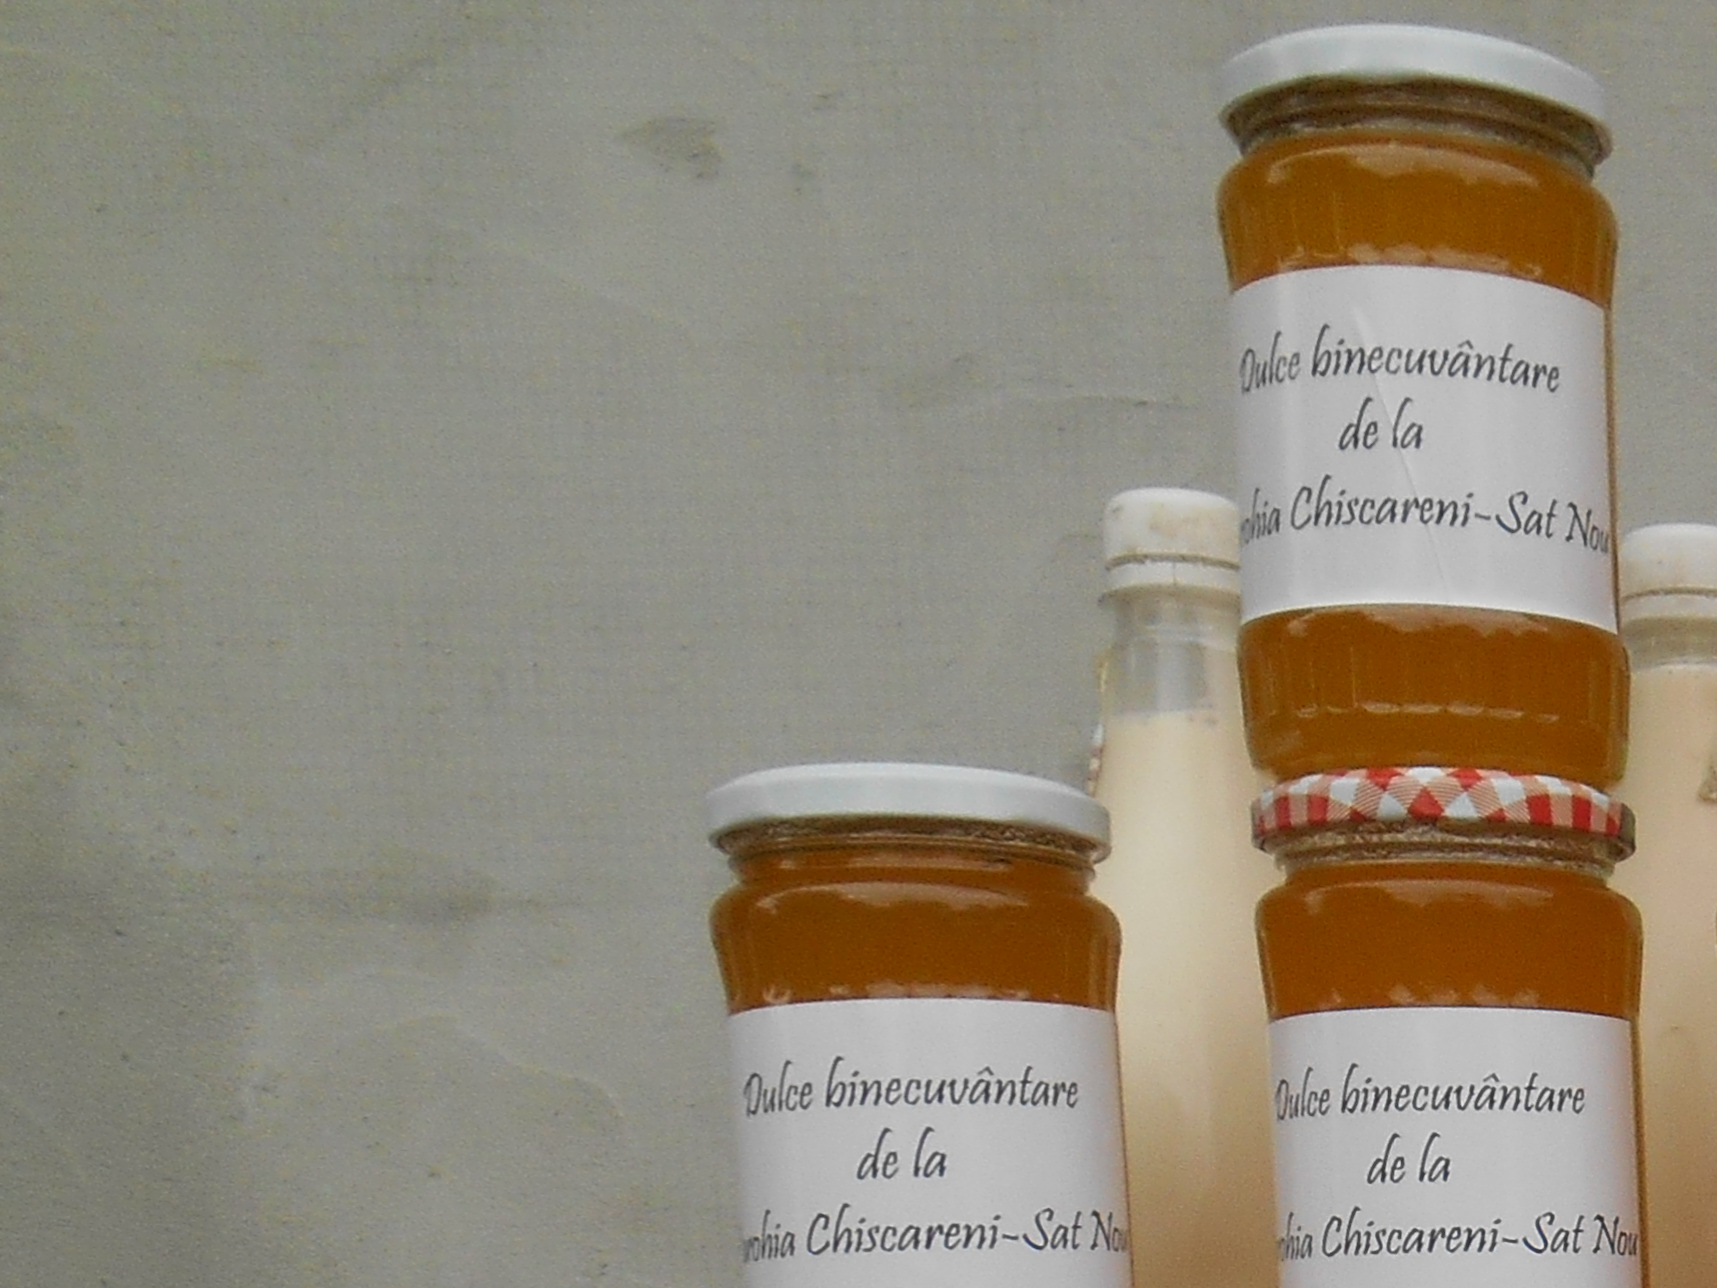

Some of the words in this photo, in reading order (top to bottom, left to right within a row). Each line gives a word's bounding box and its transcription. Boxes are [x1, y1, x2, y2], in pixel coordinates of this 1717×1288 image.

[1240, 331, 1300, 393] Dulce
[1311, 324, 1560, 392] binecuvântare
[1339, 397, 1378, 451] de
[1392, 397, 1423, 449] la
[1291, 476, 1557, 538] Chiscareni-Sat
[744, 1061, 812, 1117] Dulce
[825, 1056, 1079, 1109] binecuvântare
[1276, 1067, 1330, 1121] Dulce
[1341, 1063, 1585, 1114] binecuvântare
[856, 1127, 898, 1180] de
[912, 1126, 947, 1178] la
[1367, 1133, 1405, 1185] de
[1418, 1132, 1451, 1182] la
[806, 1203, 1082, 1255] Chiscareni-Sat
[1321, 1206, 1584, 1257] Chiscareni-Sat
[1592, 1215, 1638, 1256] Nou
